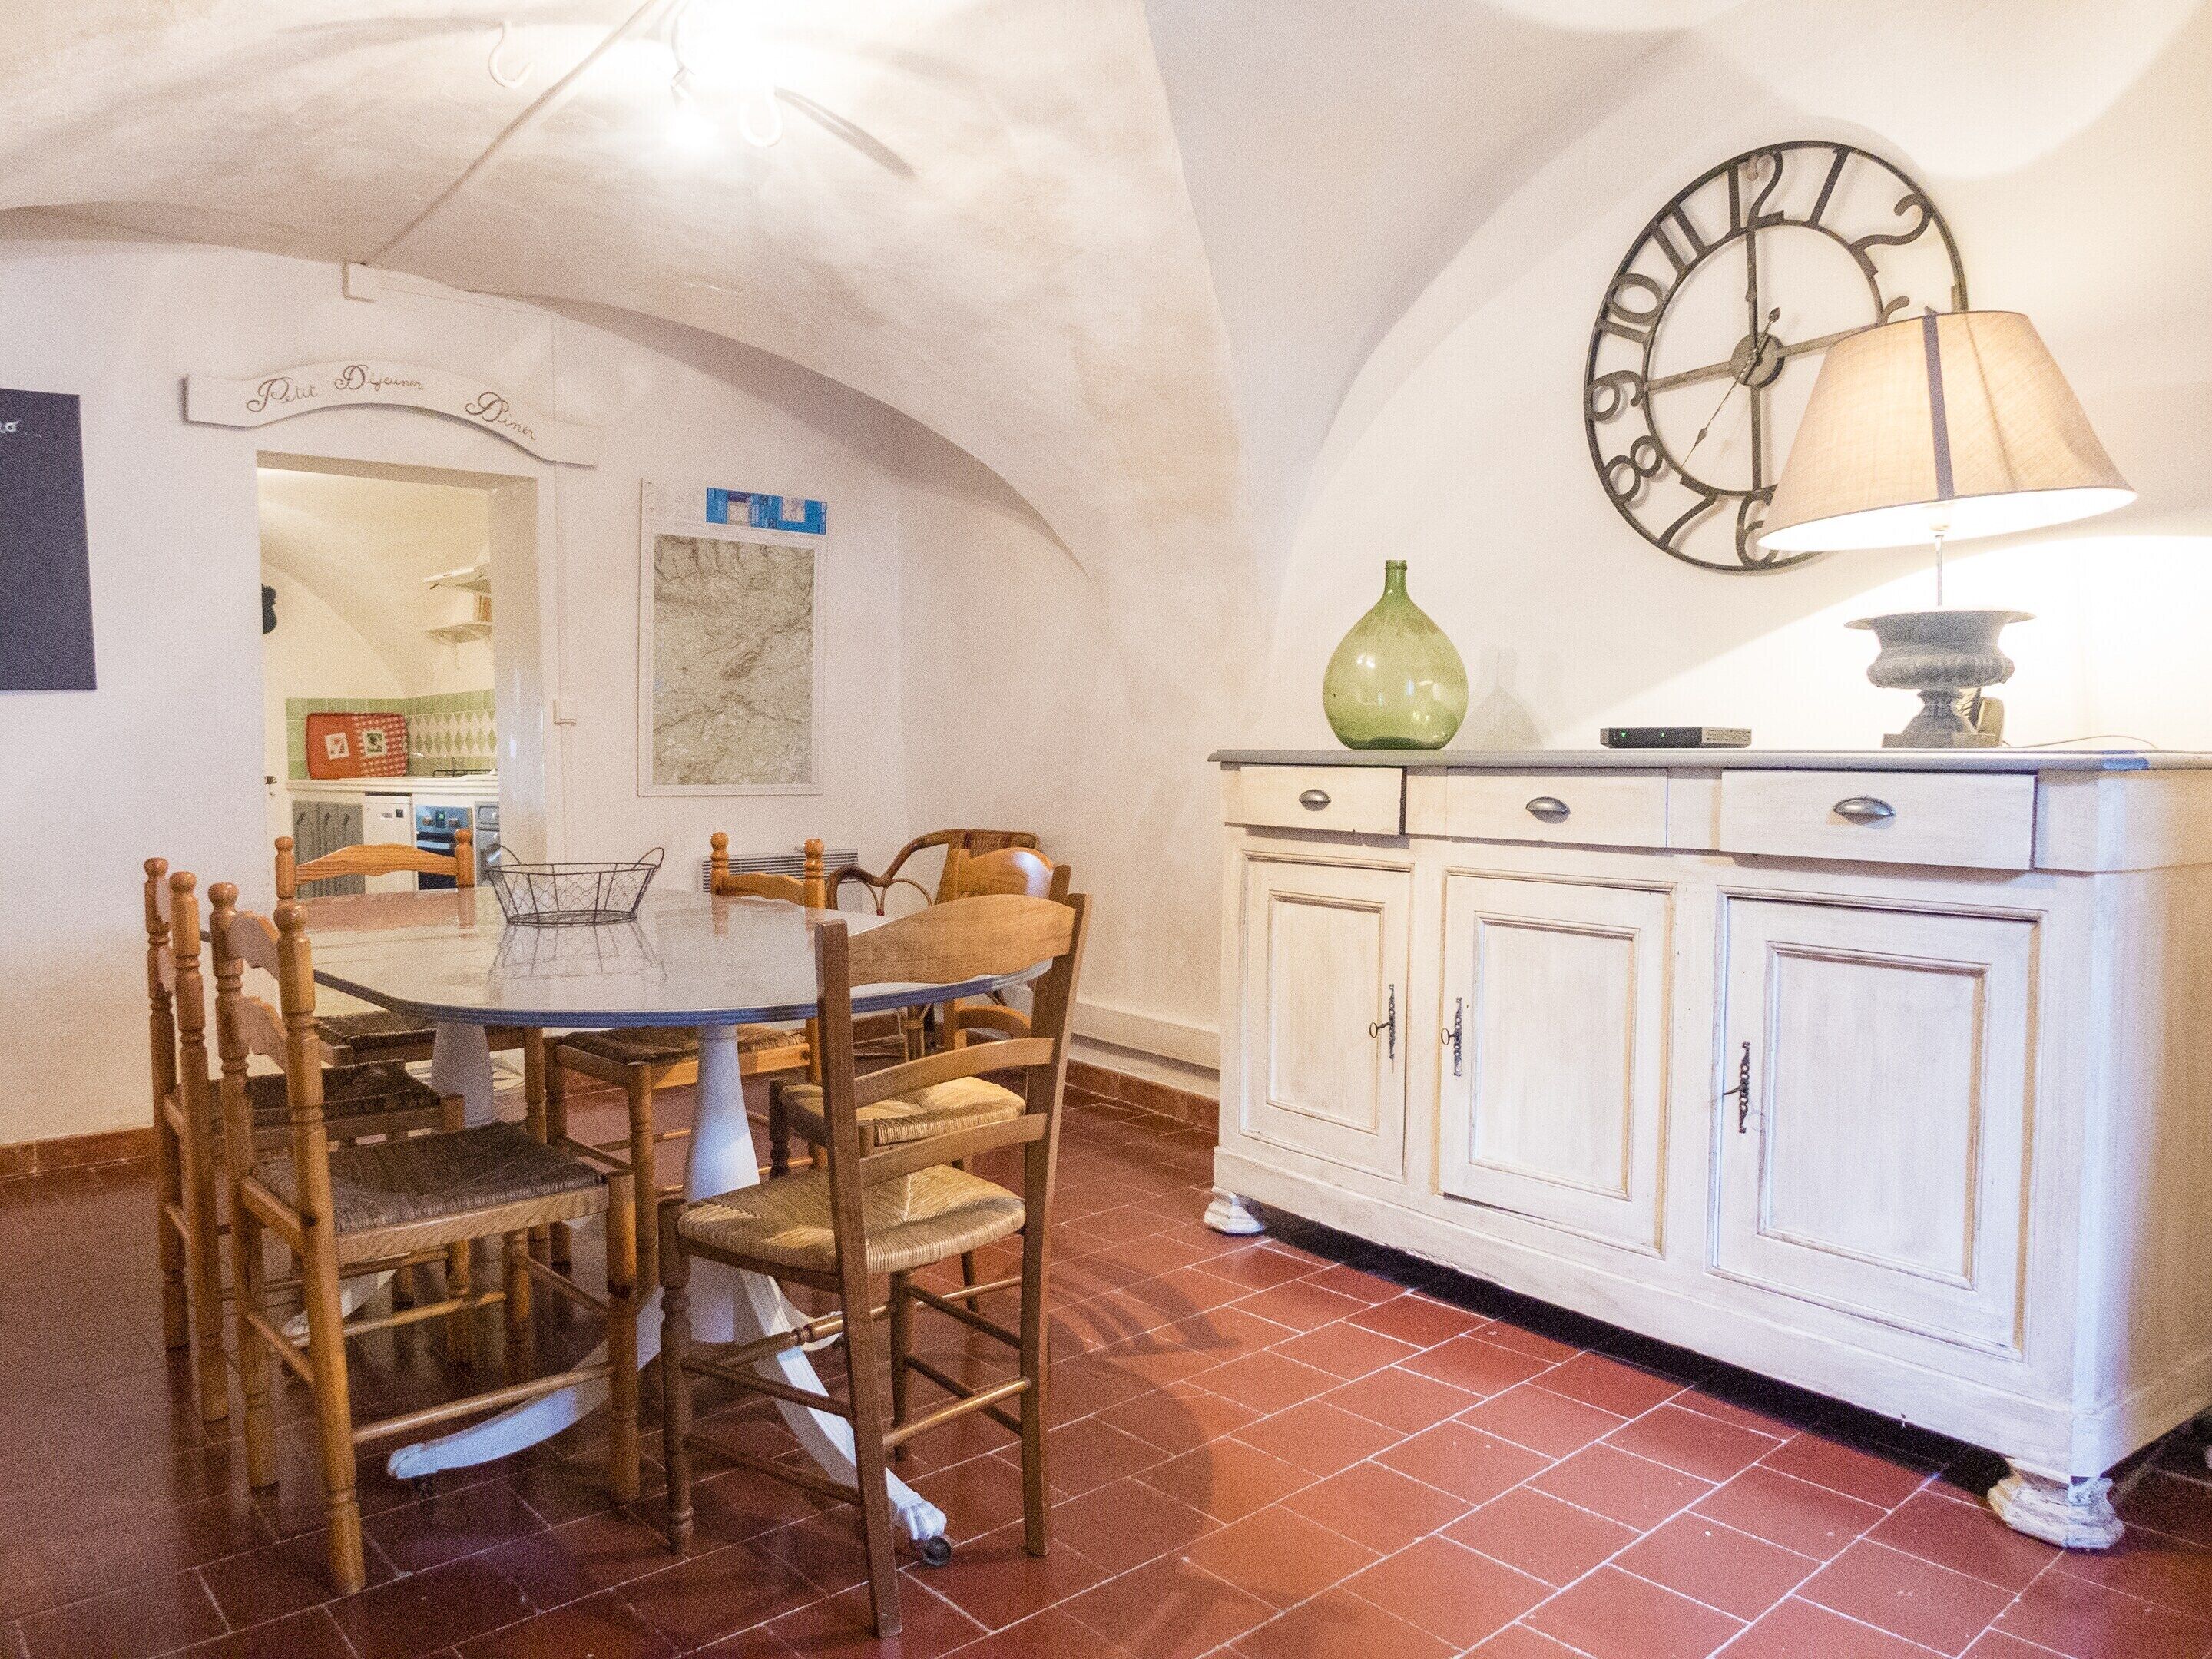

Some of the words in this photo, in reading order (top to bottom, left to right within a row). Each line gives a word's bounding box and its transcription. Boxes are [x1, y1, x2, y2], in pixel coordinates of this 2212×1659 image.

[1727, 149, 1785, 231] 12
[1807, 146, 1852, 228] 1
[1651, 202, 1710, 276] 11
[1851, 193, 1934, 278] 2
[1597, 273, 1665, 344] 10
[246, 377, 318, 412] Petit
[1584, 369, 1645, 422] 9
[1607, 434, 1664, 503] 8
[1657, 474, 1720, 549] 7
